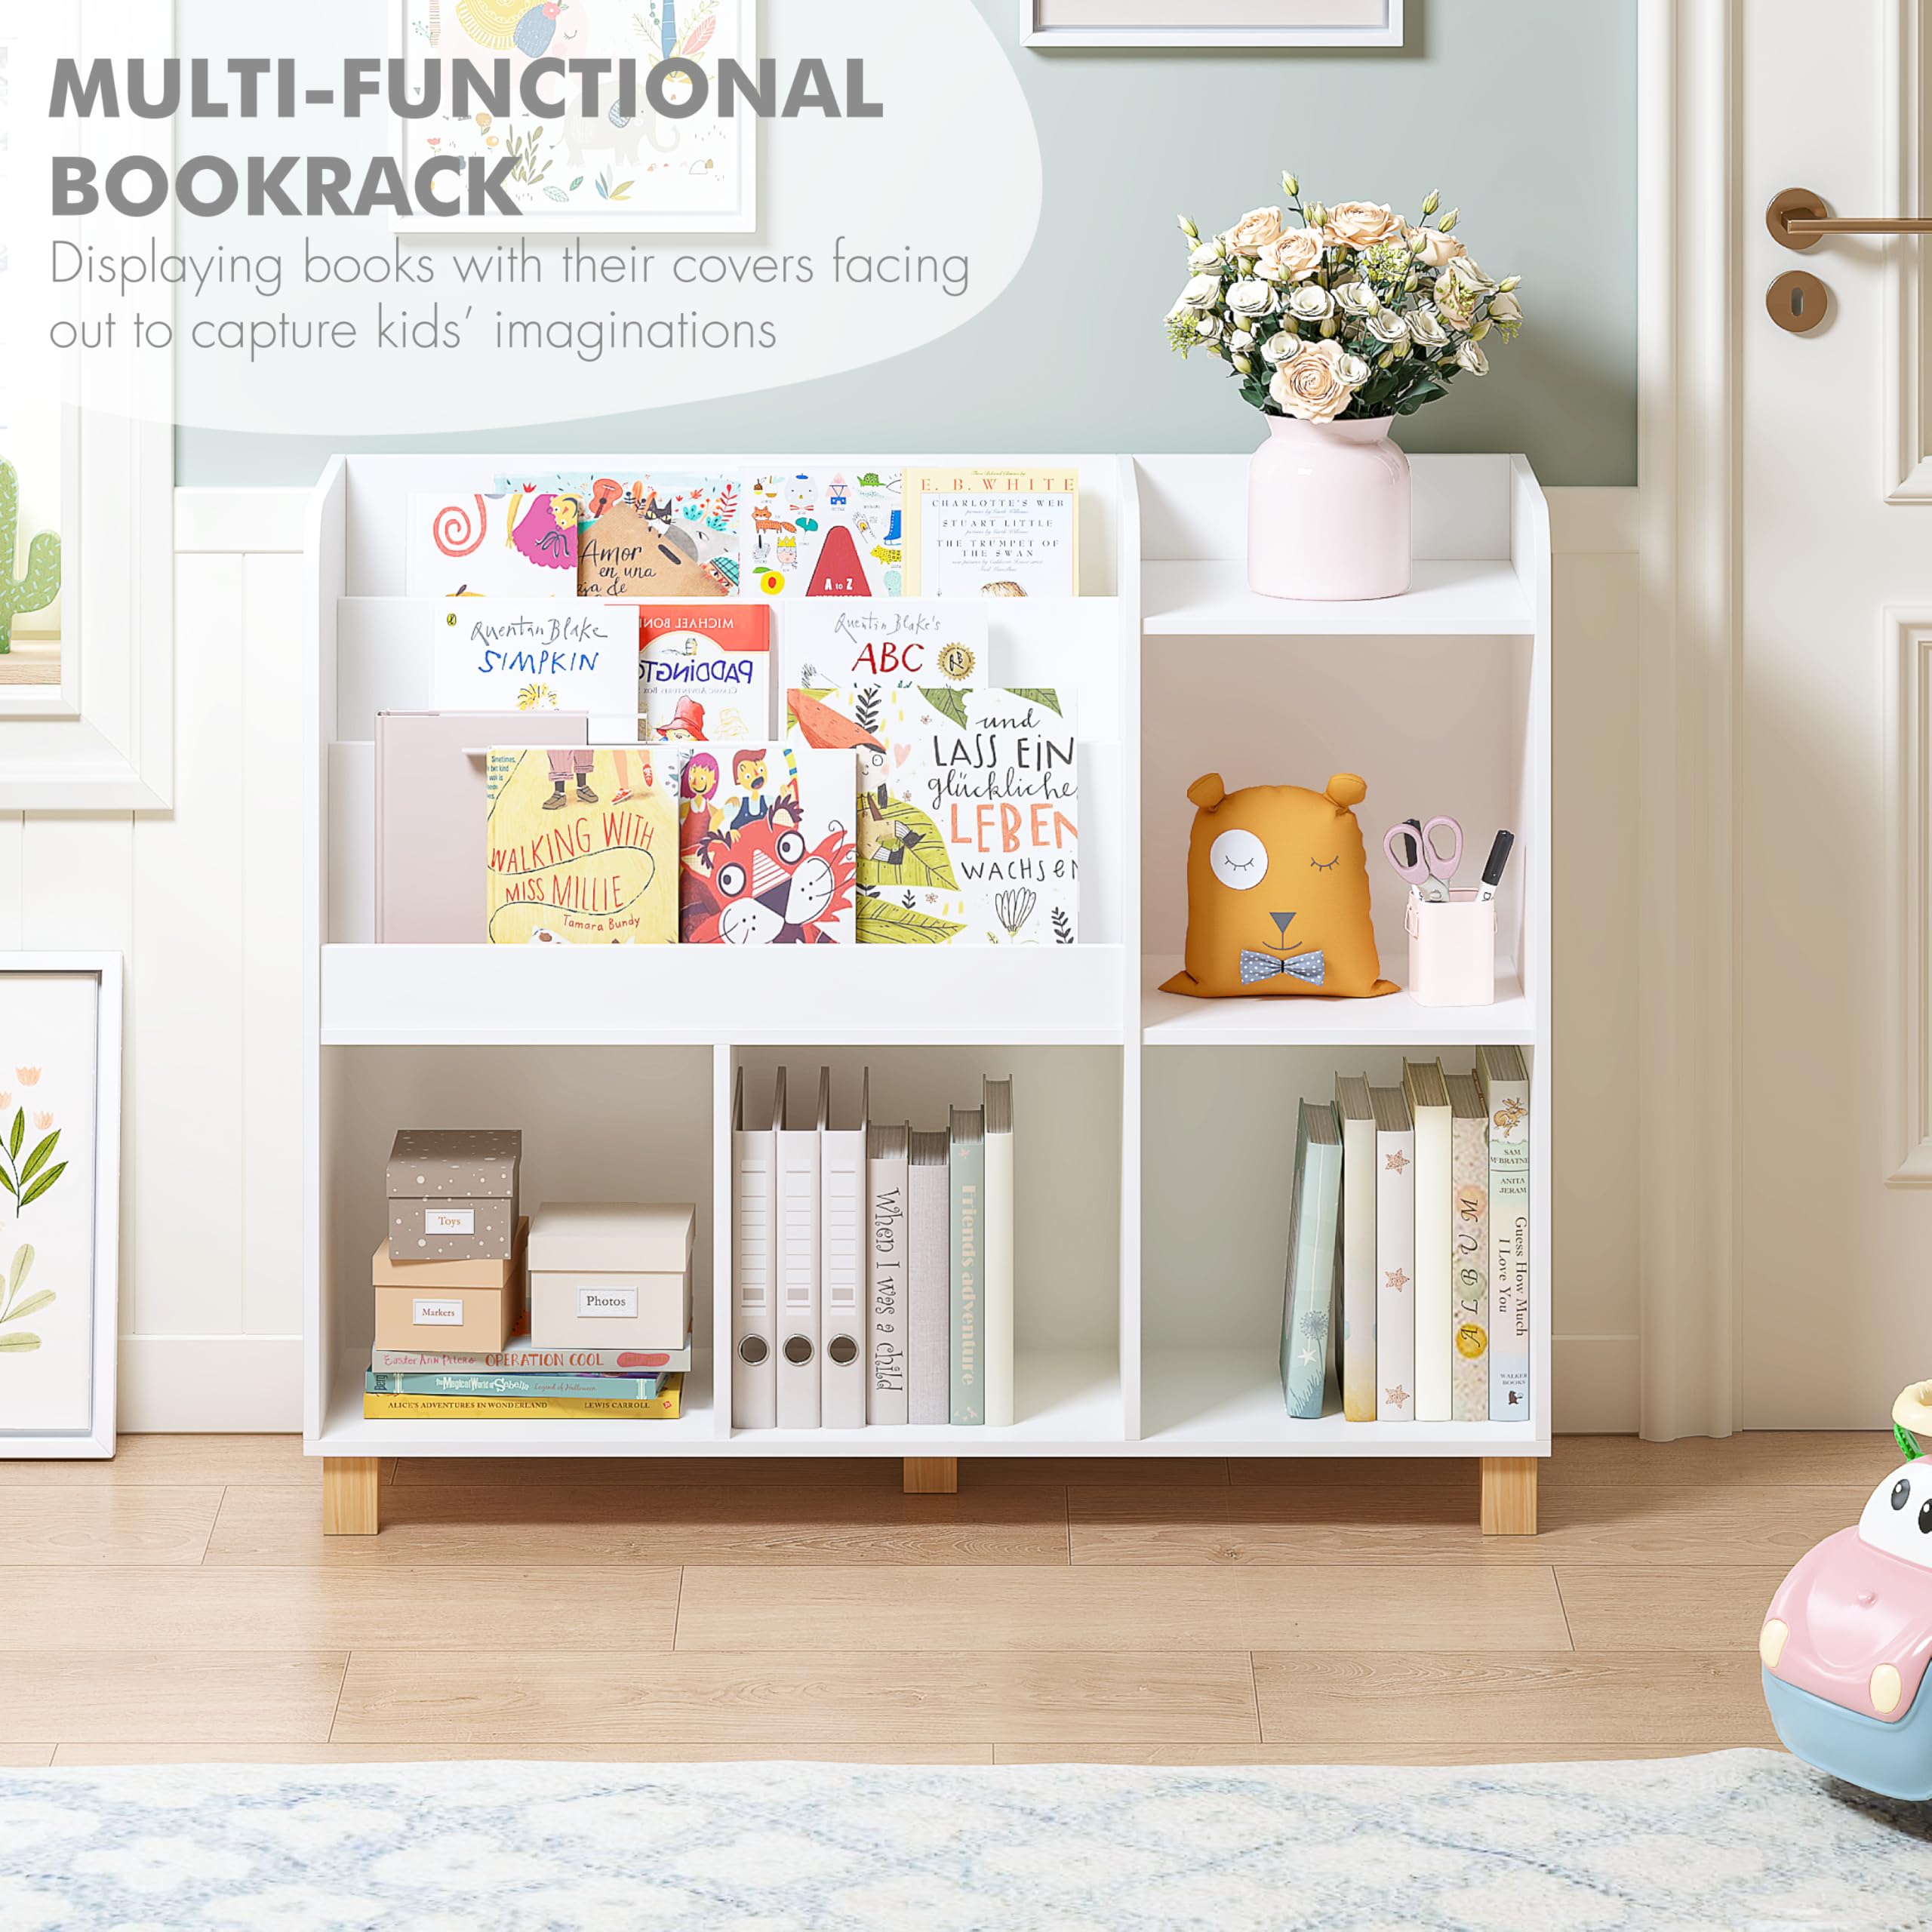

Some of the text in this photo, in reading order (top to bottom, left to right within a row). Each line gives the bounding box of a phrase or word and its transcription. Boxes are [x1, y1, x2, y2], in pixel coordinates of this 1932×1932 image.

[981, 478, 1075, 491] WHITE
[932, 499, 1064, 507] CHARLOTTE'S WEB
[578, 539, 641, 567] Amor
[937, 539, 1060, 547] THE TRUMPET OF
[598, 567, 656, 579] en una
[824, 578, 854, 590] A to Z
[606, 576, 628, 596] de
[470, 615, 608, 646] Quentin Blake
[834, 611, 941, 644] Quentin Blake's
[478, 649, 599, 674] SIMPKIN
[851, 641, 925, 675] ABC
[975, 708, 1041, 730] und
[934, 734, 997, 769] LASS
[491, 811, 655, 873] WALKING WITH
[506, 874, 624, 912] MISS MILLIE
[563, 913, 641, 932] Tamara Bundy
[438, 1216, 462, 1228] Toys
[875, 1187, 904, 1253] When
[1499, 1249, 1511, 1281] Love
[1515, 1217, 1528, 1337] Guess How Much
[875, 1275, 897, 1316] was
[961, 1184, 977, 1386] Friends adventure
[586, 1295, 626, 1306] Photos
[1499, 1286, 1512, 1313] You
[422, 1308, 455, 1317] Markers
[875, 1322, 895, 1334] a
[485, 1352, 564, 1367] OPERATION
[569, 1352, 605, 1367] COOL
[875, 1341, 903, 1392] child
[442, 1376, 471, 1391] Magical
